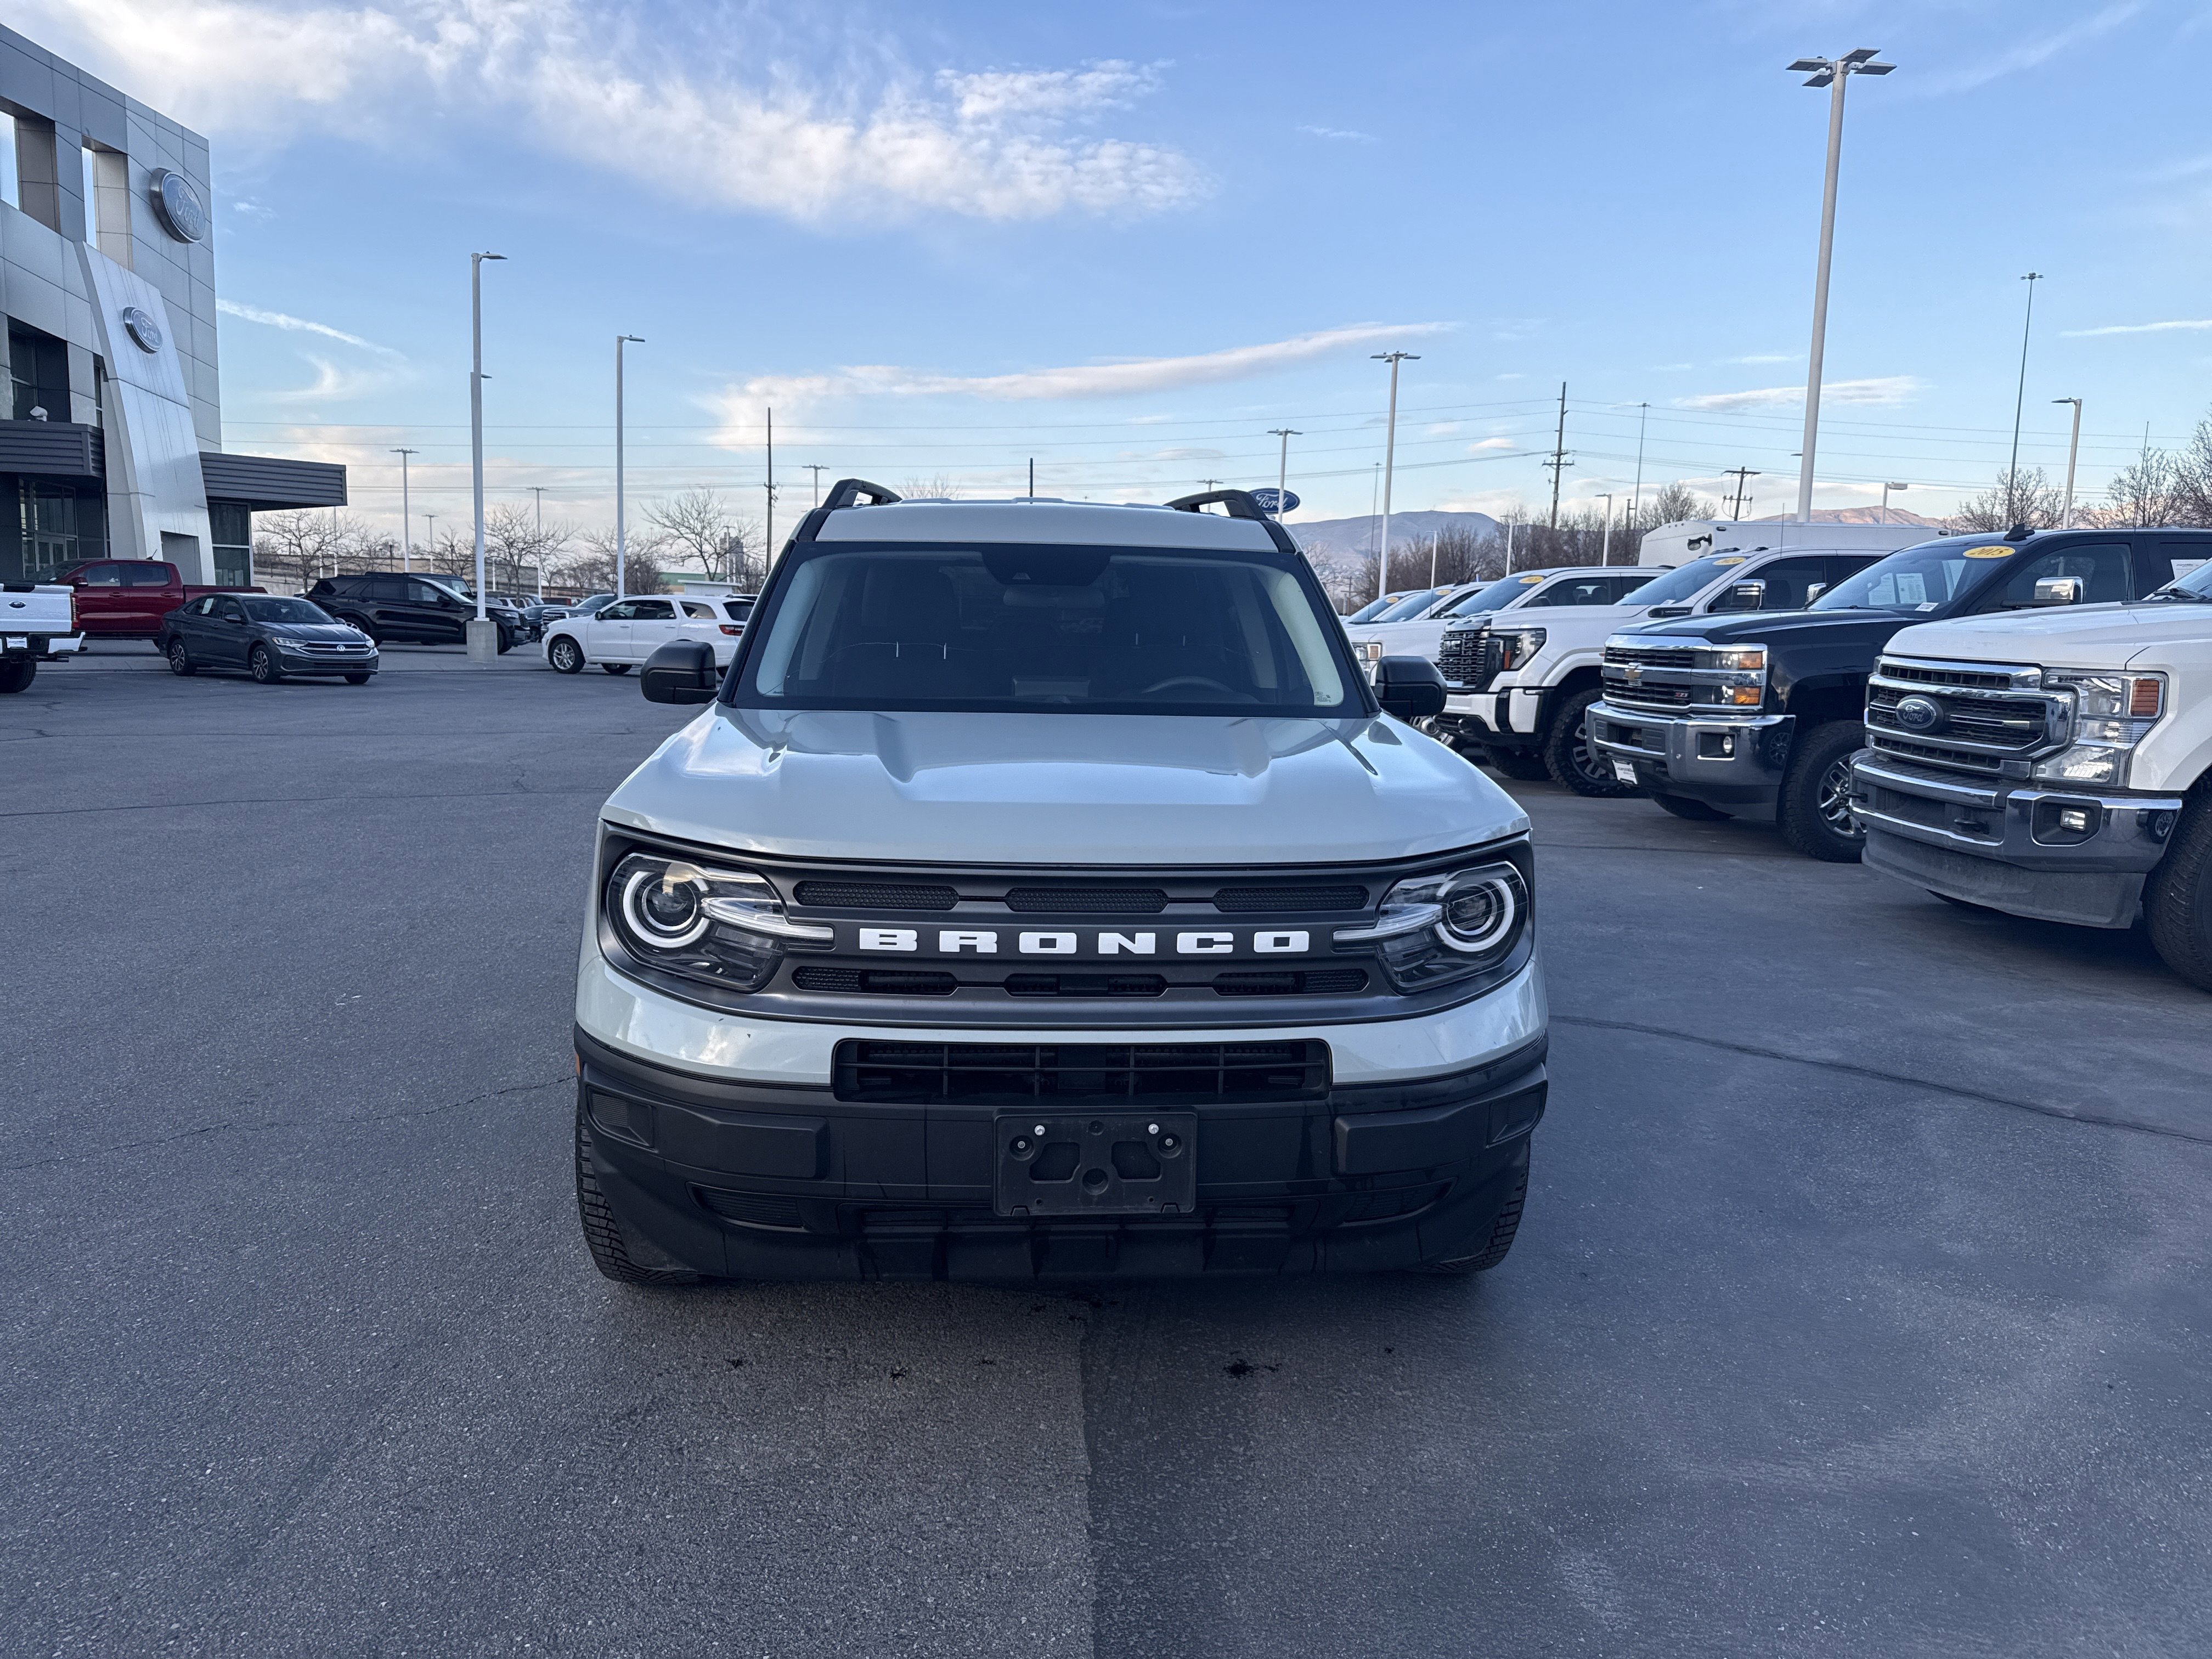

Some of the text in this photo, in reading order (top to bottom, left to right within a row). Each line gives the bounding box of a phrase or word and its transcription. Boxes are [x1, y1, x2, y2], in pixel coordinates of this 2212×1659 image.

[176, 186, 200, 231] Ford
[140, 317, 159, 343] Ford
[1903, 704, 1925, 722] Ford
[859, 928, 1309, 954] BRONCO
